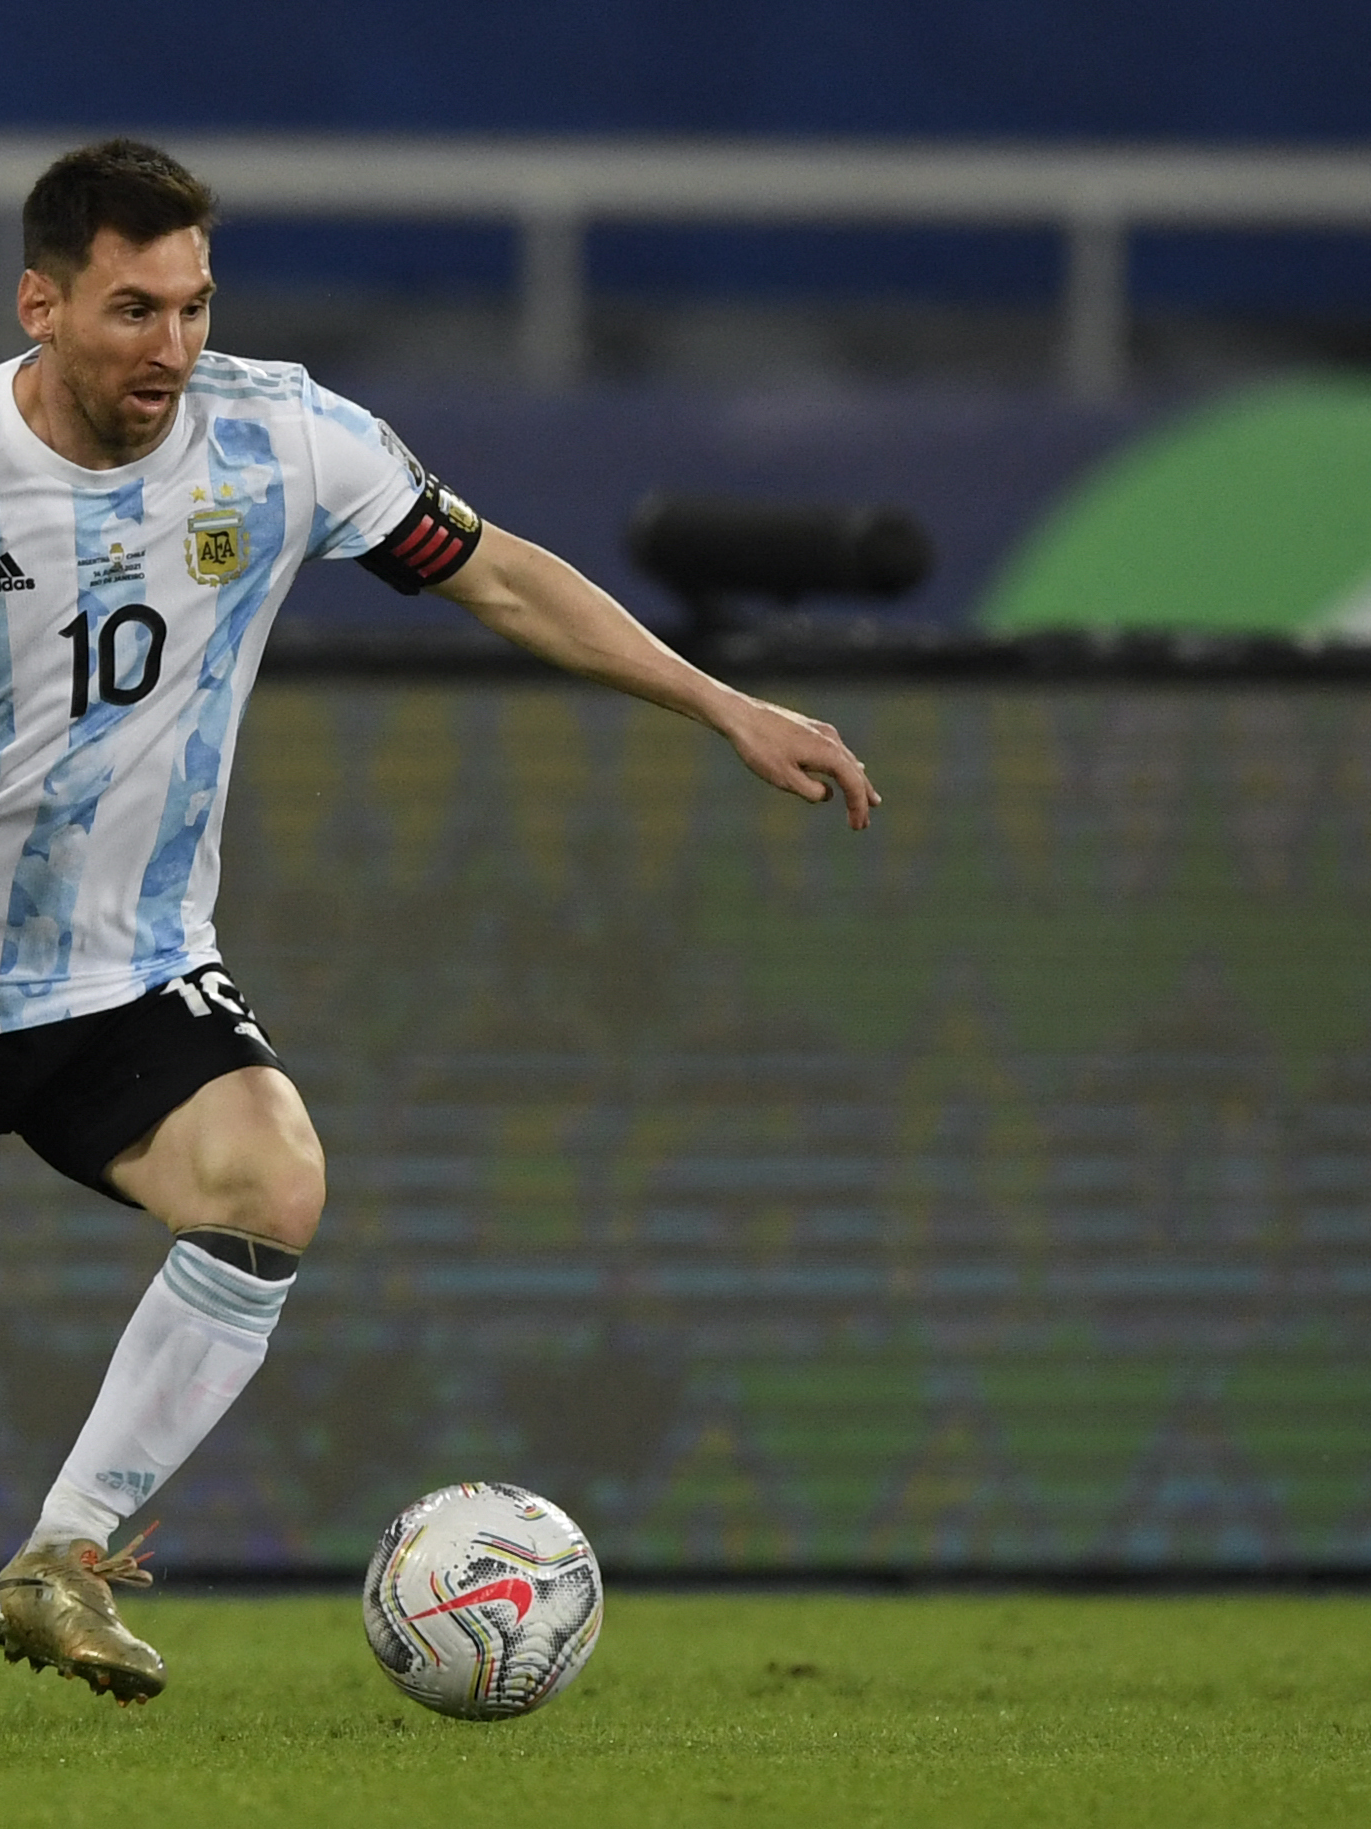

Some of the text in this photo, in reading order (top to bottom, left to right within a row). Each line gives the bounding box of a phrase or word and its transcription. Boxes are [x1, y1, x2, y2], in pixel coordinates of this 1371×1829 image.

[126, 549, 146, 560] CHILE
[200, 531, 235, 565] AFA
[90, 579, 102, 587] RIO
[114, 572, 145, 583] JANEIRO
[124, 563, 141, 572] 2021
[57, 603, 167, 718] 10
[159, 971, 256, 1018] 10
